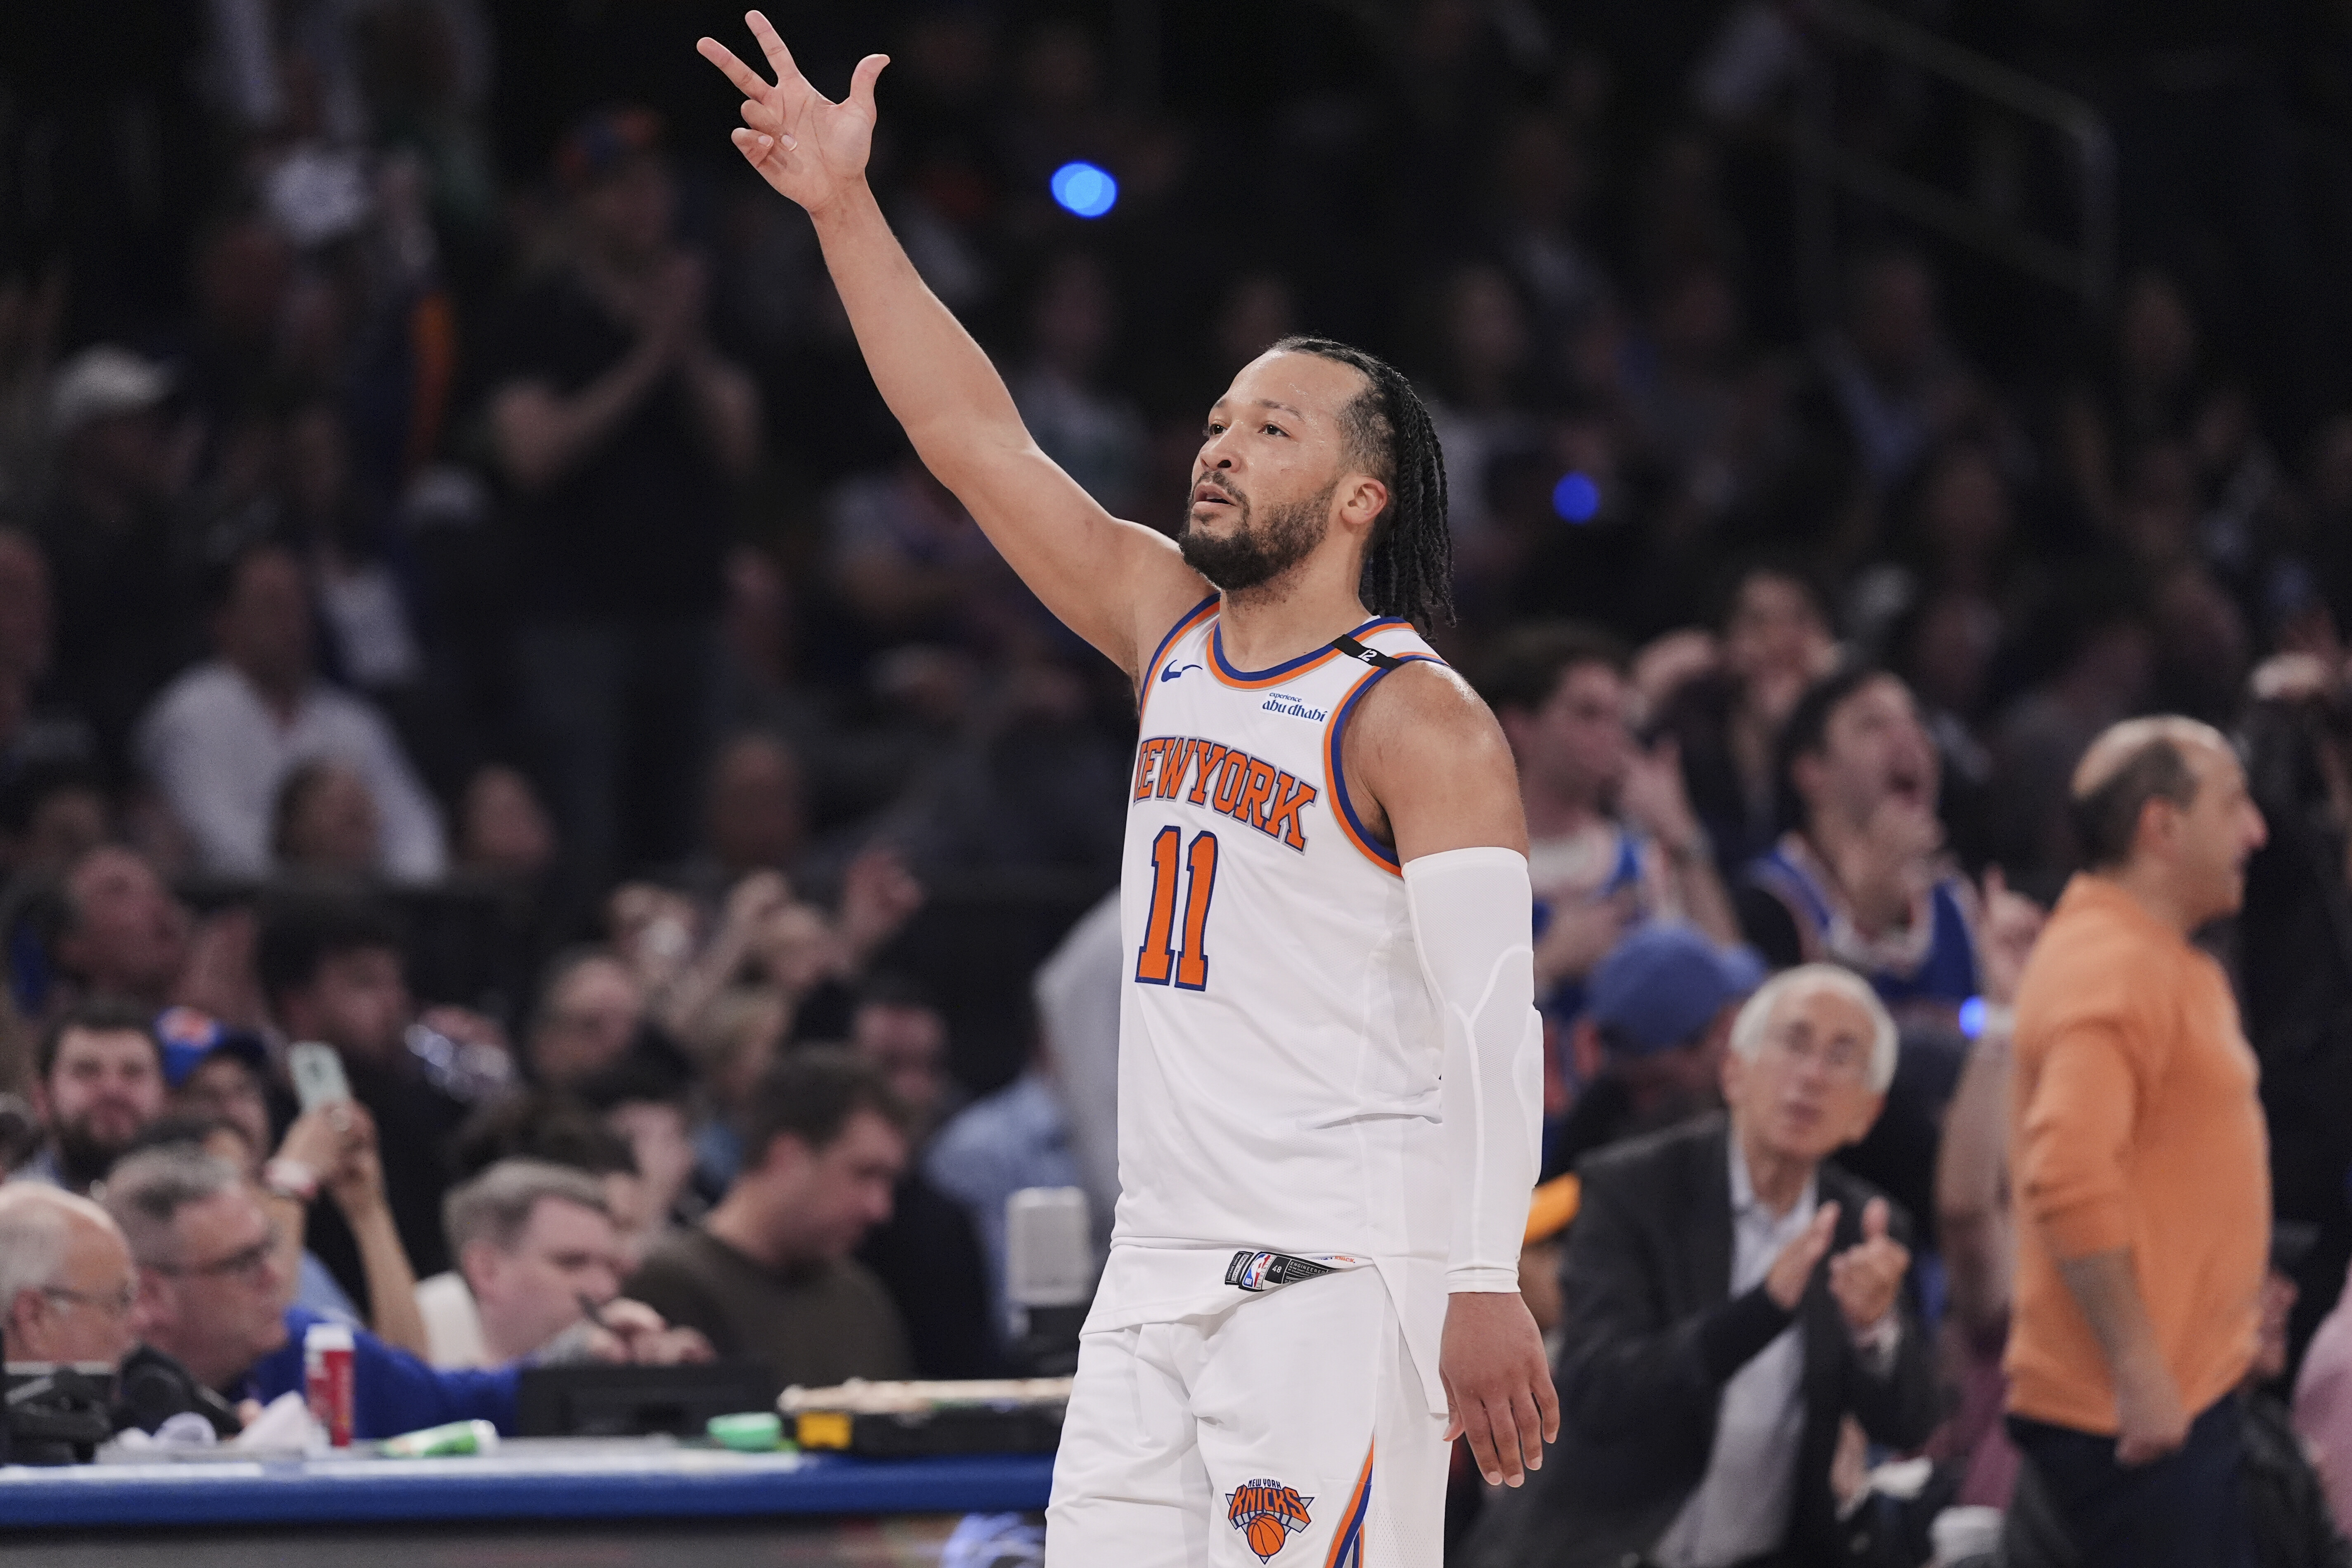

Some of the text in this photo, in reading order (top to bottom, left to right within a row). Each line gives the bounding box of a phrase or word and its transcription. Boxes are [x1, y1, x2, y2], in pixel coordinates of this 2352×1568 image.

[1269, 692, 1302, 702] experience
[1262, 699, 1328, 722] abu dhabi
[1135, 825, 1218, 992] 11
[1290, 1261, 1325, 1274] ENGINEERED
[1248, 1478, 1281, 1489] NEW YORK
[1228, 1484, 1312, 1524] KNICKS
